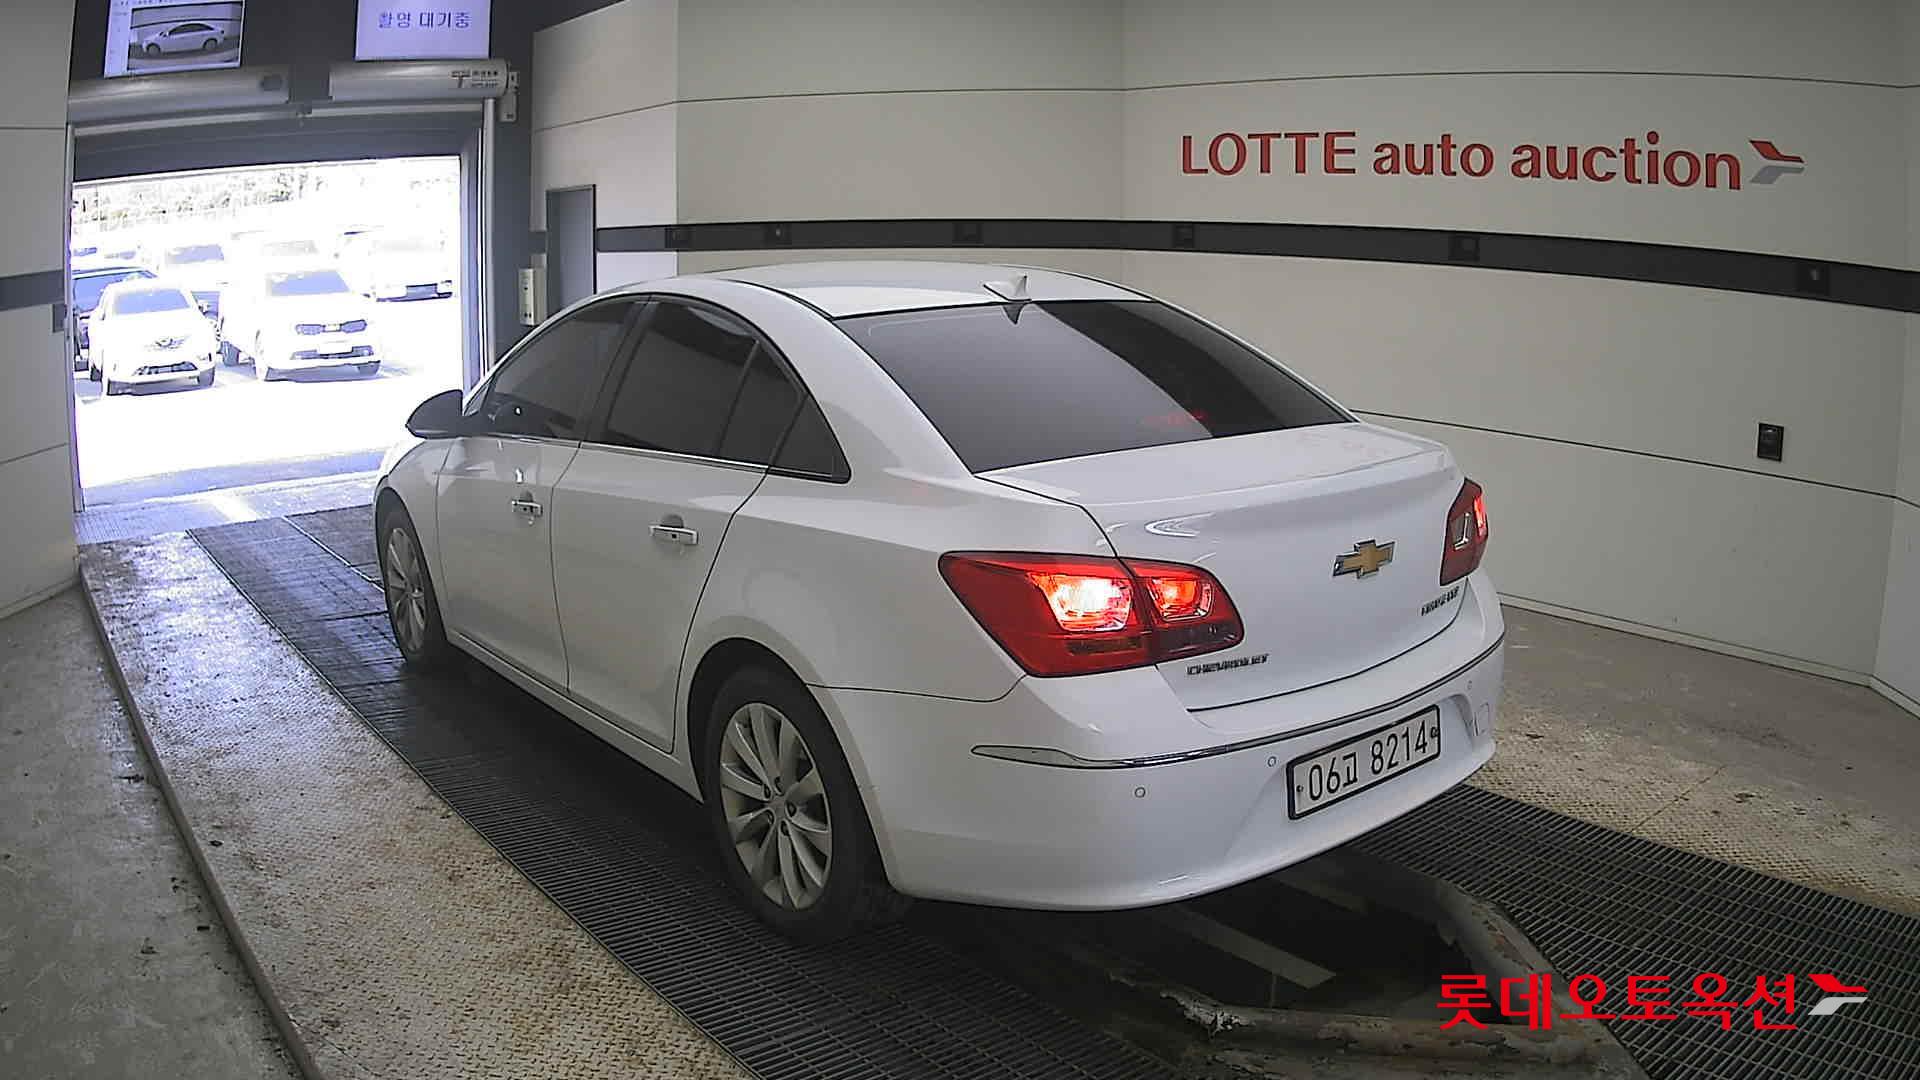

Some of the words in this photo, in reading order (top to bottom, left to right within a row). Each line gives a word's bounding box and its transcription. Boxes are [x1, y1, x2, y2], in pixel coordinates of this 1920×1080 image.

[419, 11, 471, 29] 대기중
[1182, 131, 1357, 175] LOTTE
[1373, 133, 1494, 177] auto
[1511, 131, 1741, 190] auction
[1309, 752, 1358, 801] 06고
[1371, 719, 1428, 775] 8214
